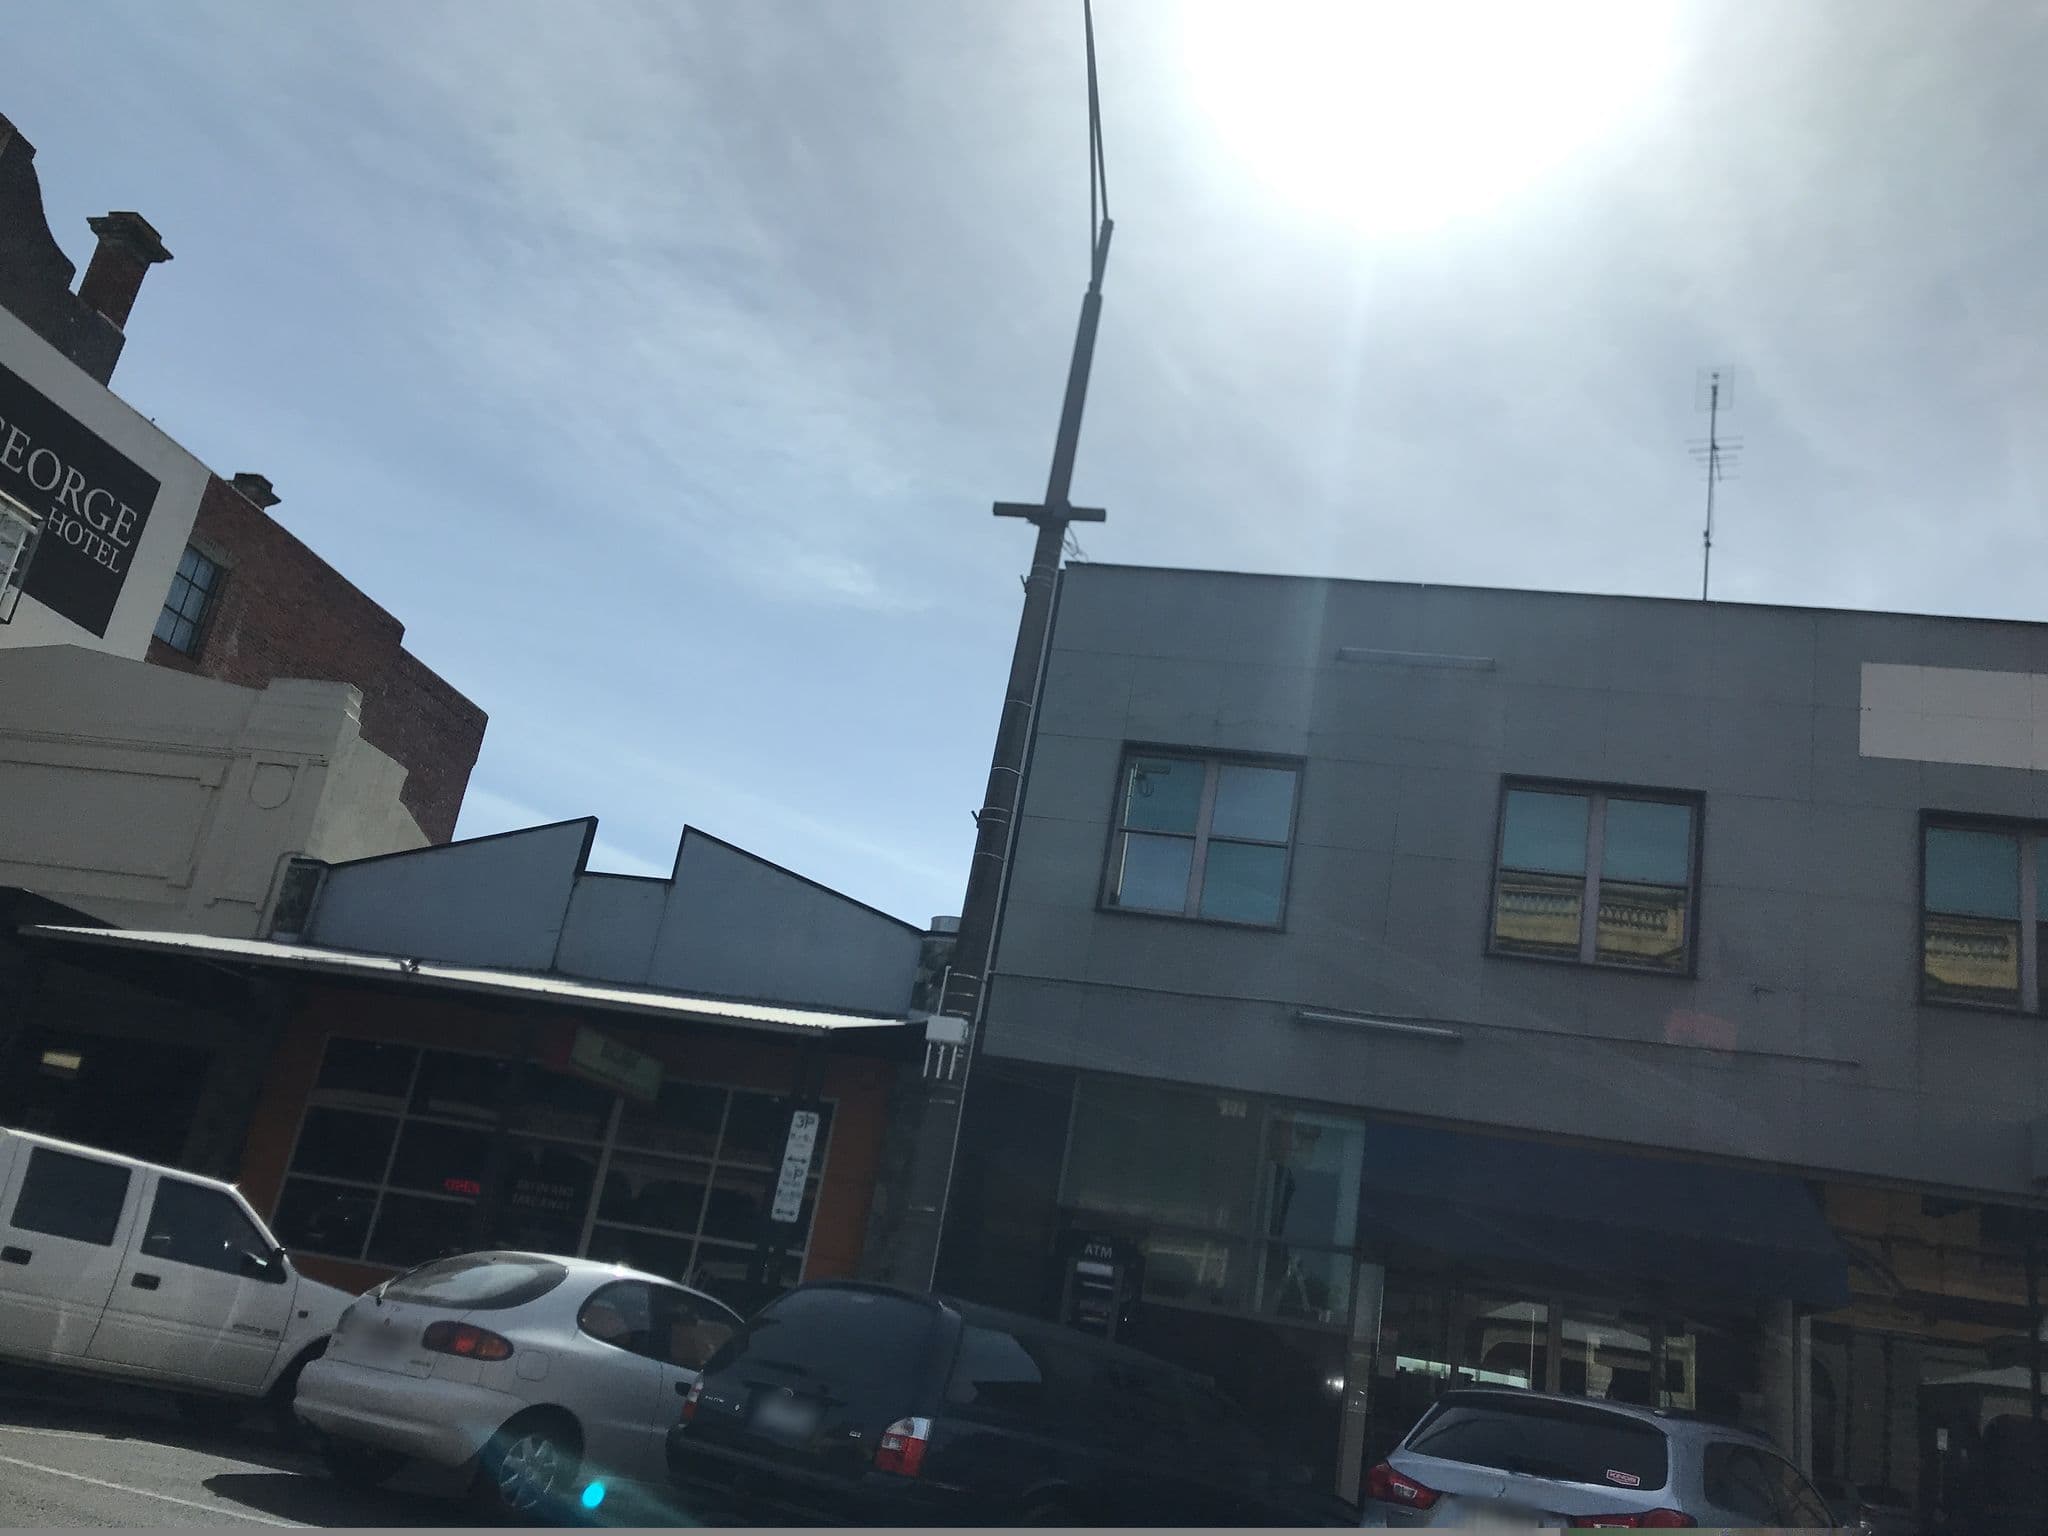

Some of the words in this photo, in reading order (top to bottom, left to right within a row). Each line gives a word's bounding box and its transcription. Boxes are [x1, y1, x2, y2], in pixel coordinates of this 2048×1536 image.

[0, 416, 137, 548] EORGE
[47, 506, 120, 574] HOTEL
[795, 1113, 815, 1129] 3P
[1084, 1243, 1112, 1259] ATM
